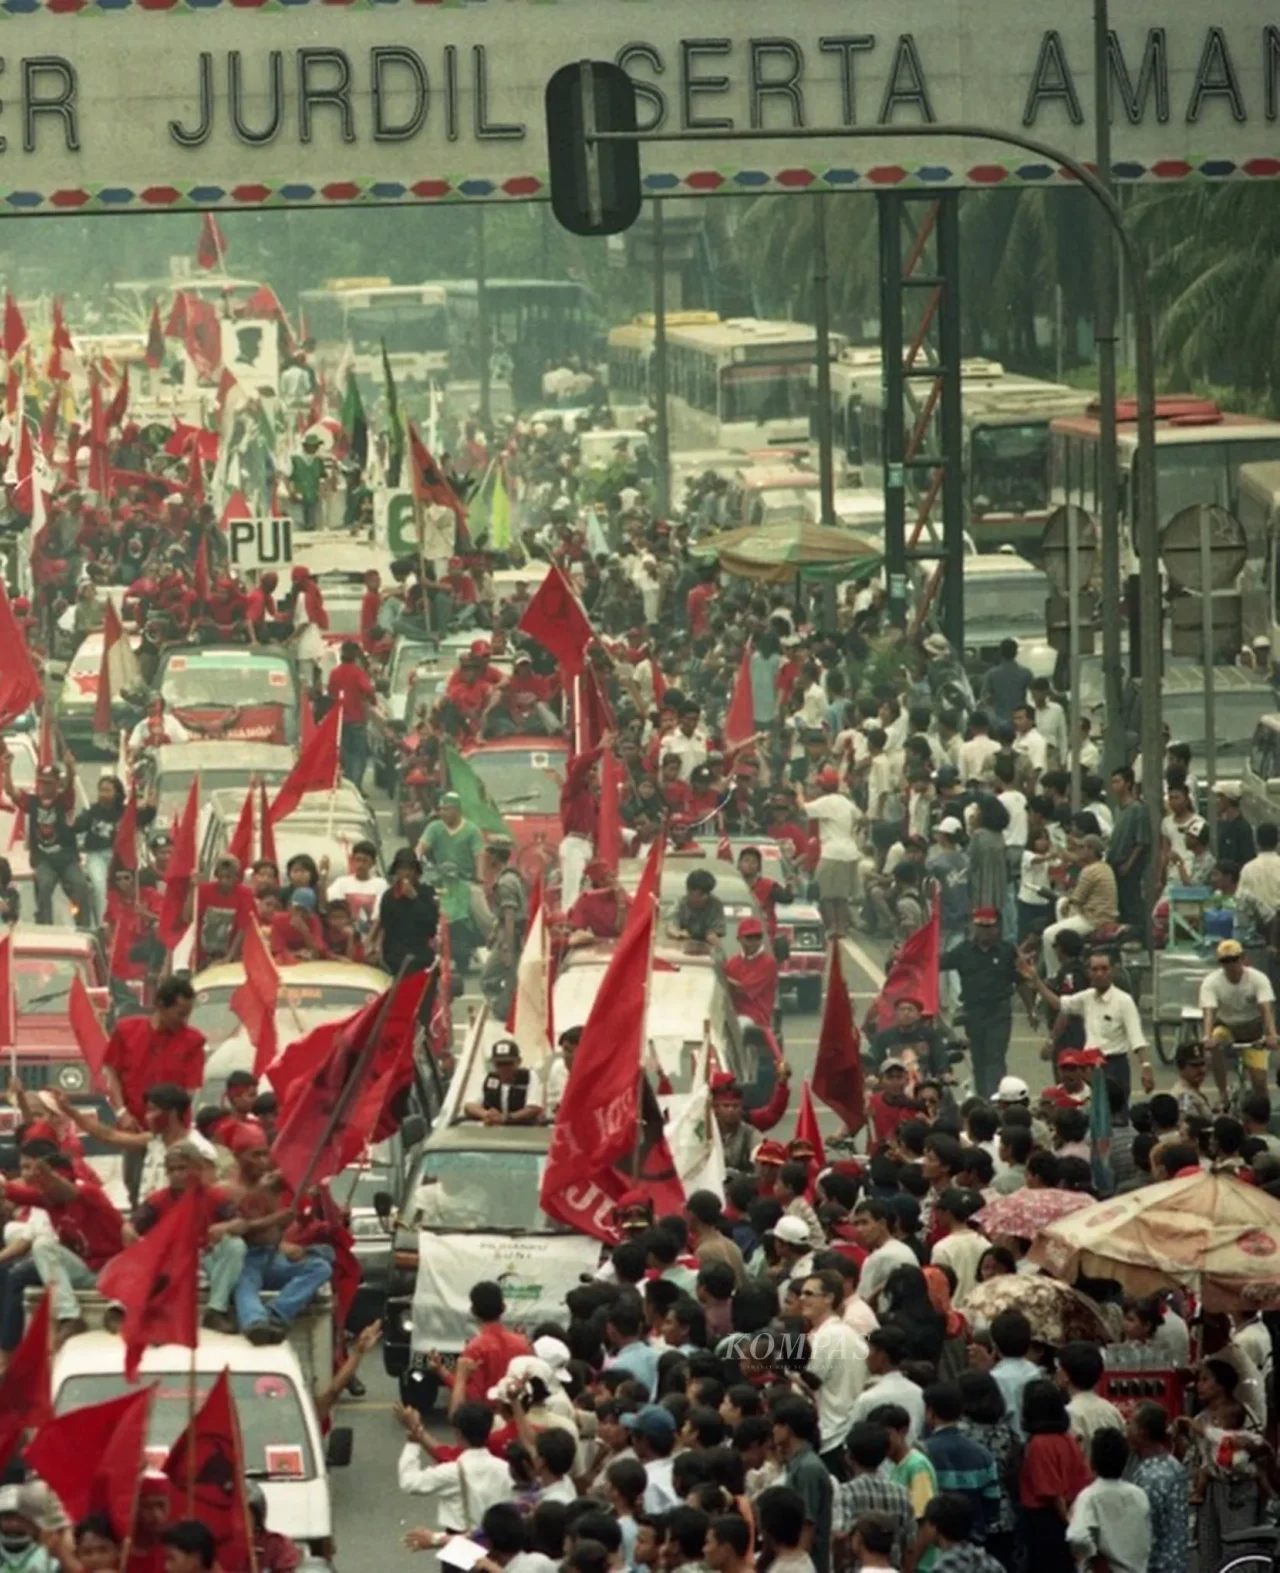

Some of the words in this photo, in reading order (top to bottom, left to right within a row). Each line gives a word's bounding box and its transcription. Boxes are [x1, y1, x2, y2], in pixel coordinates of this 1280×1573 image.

[168, 43, 526, 147] JURDIL
[615, 33, 937, 133] SERTA
[231, 520, 293, 563] PUI
